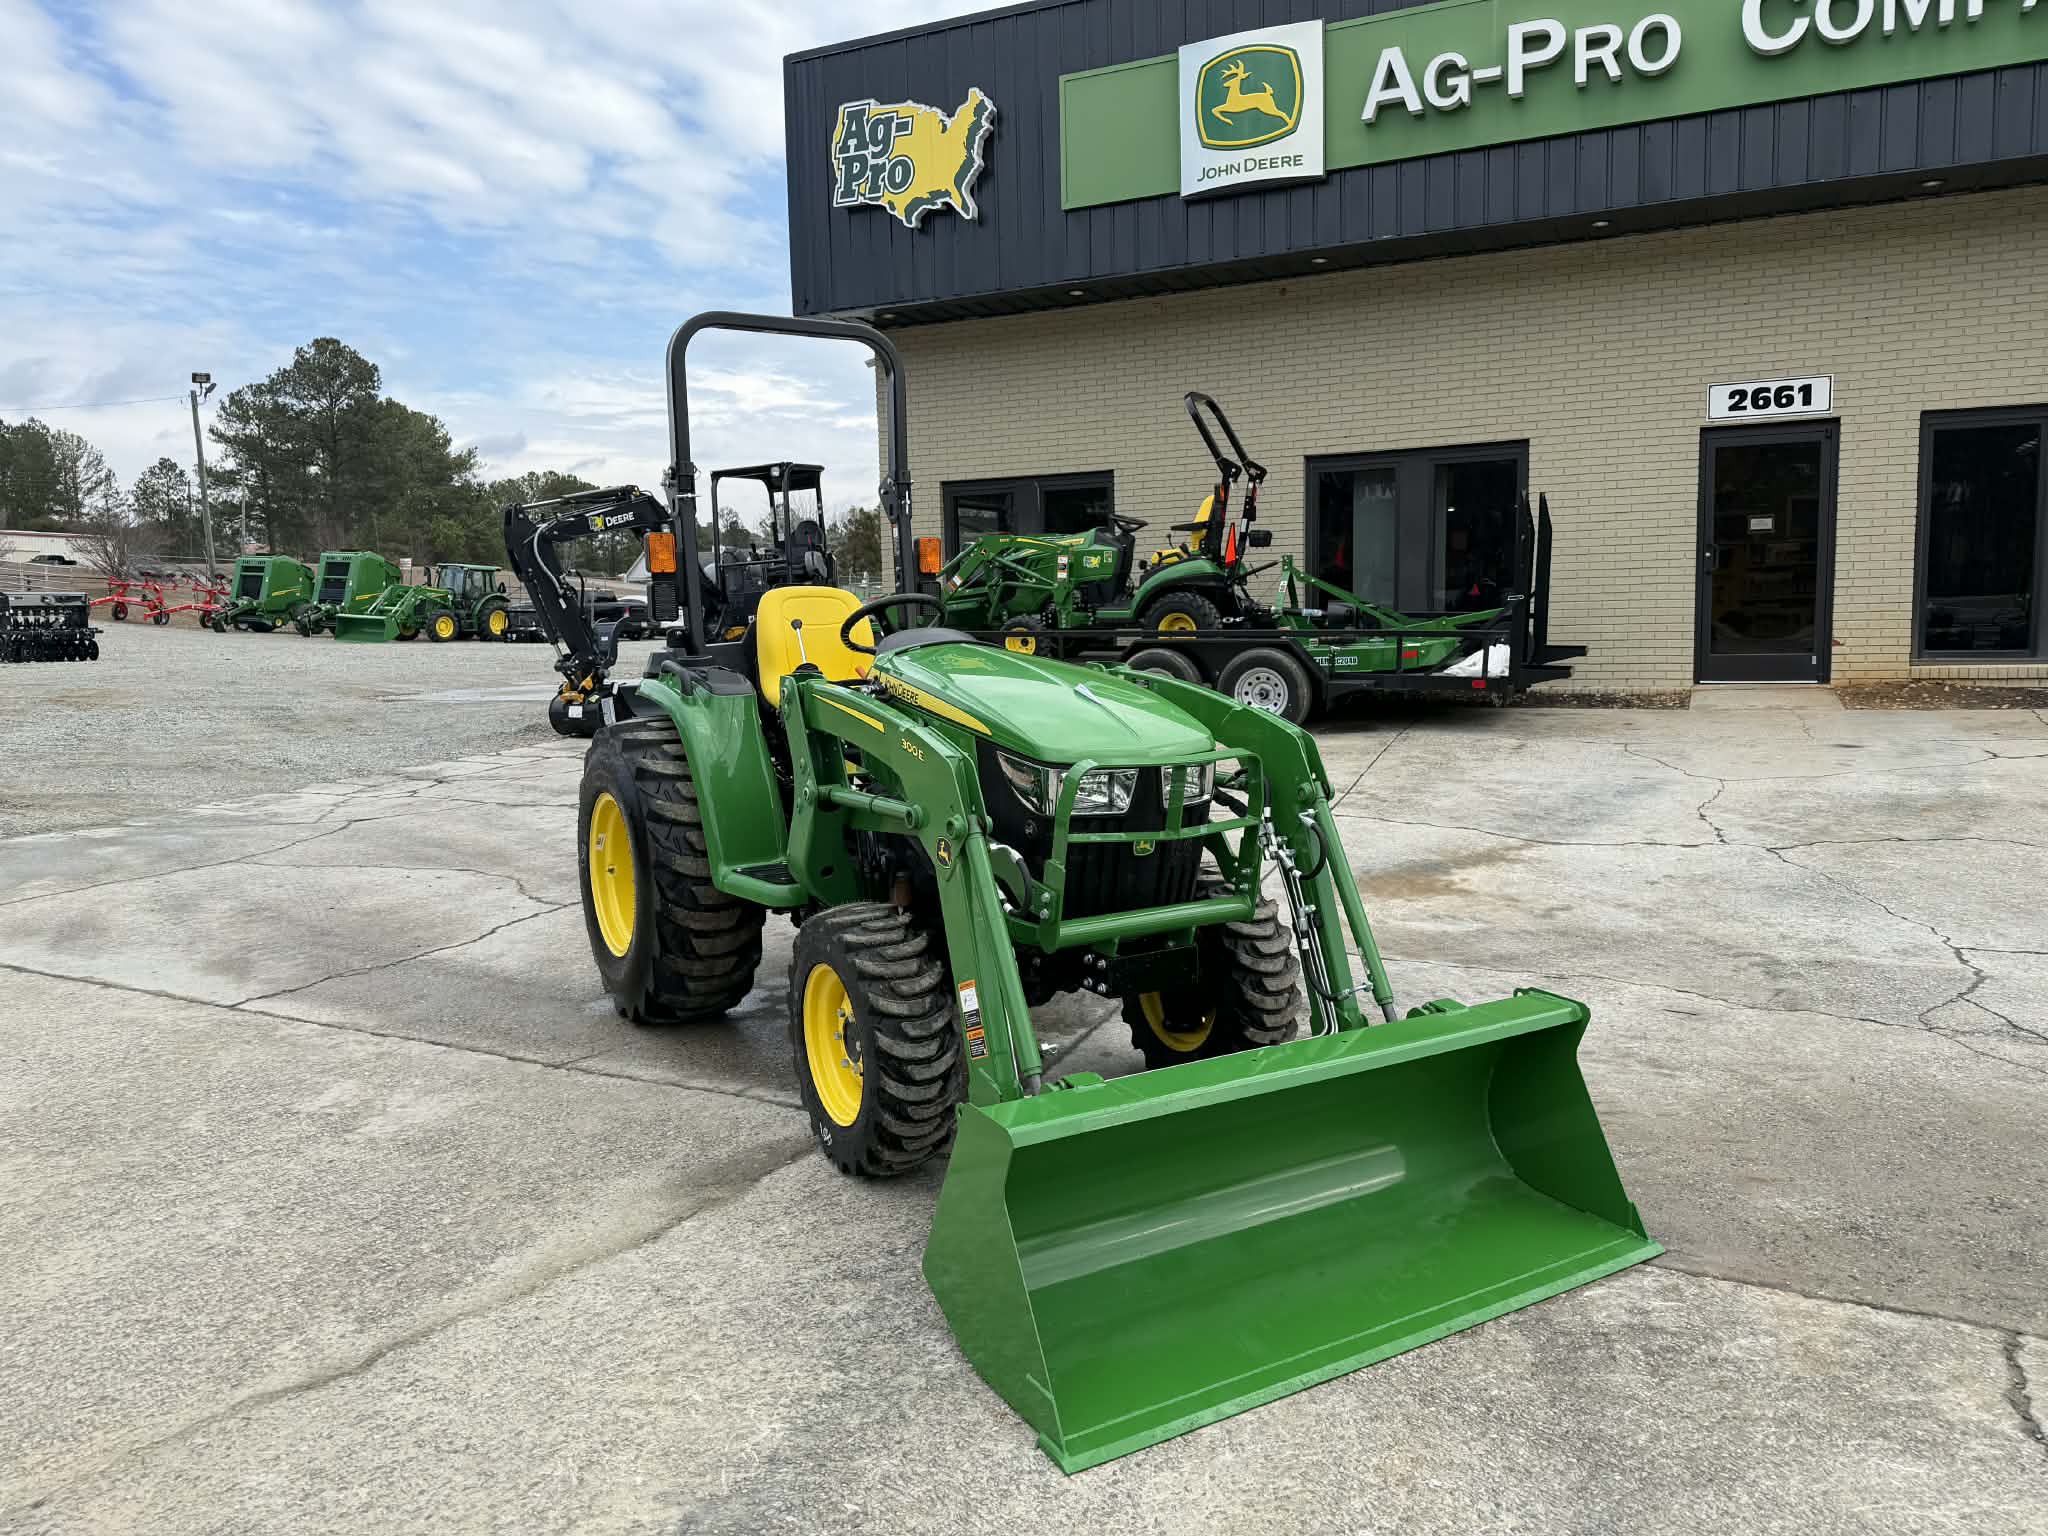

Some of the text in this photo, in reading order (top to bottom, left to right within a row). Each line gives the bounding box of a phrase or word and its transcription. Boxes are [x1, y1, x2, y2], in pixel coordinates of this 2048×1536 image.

[1741, 0, 2040, 55] COM
[837, 104, 914, 160] Ag-
[836, 154, 914, 203] Pro
[1197, 154, 1304, 182] JOHN DEERE
[1727, 383, 1813, 412] 2661
[605, 511, 635, 527] DEERE
[901, 738, 924, 761] 300E
